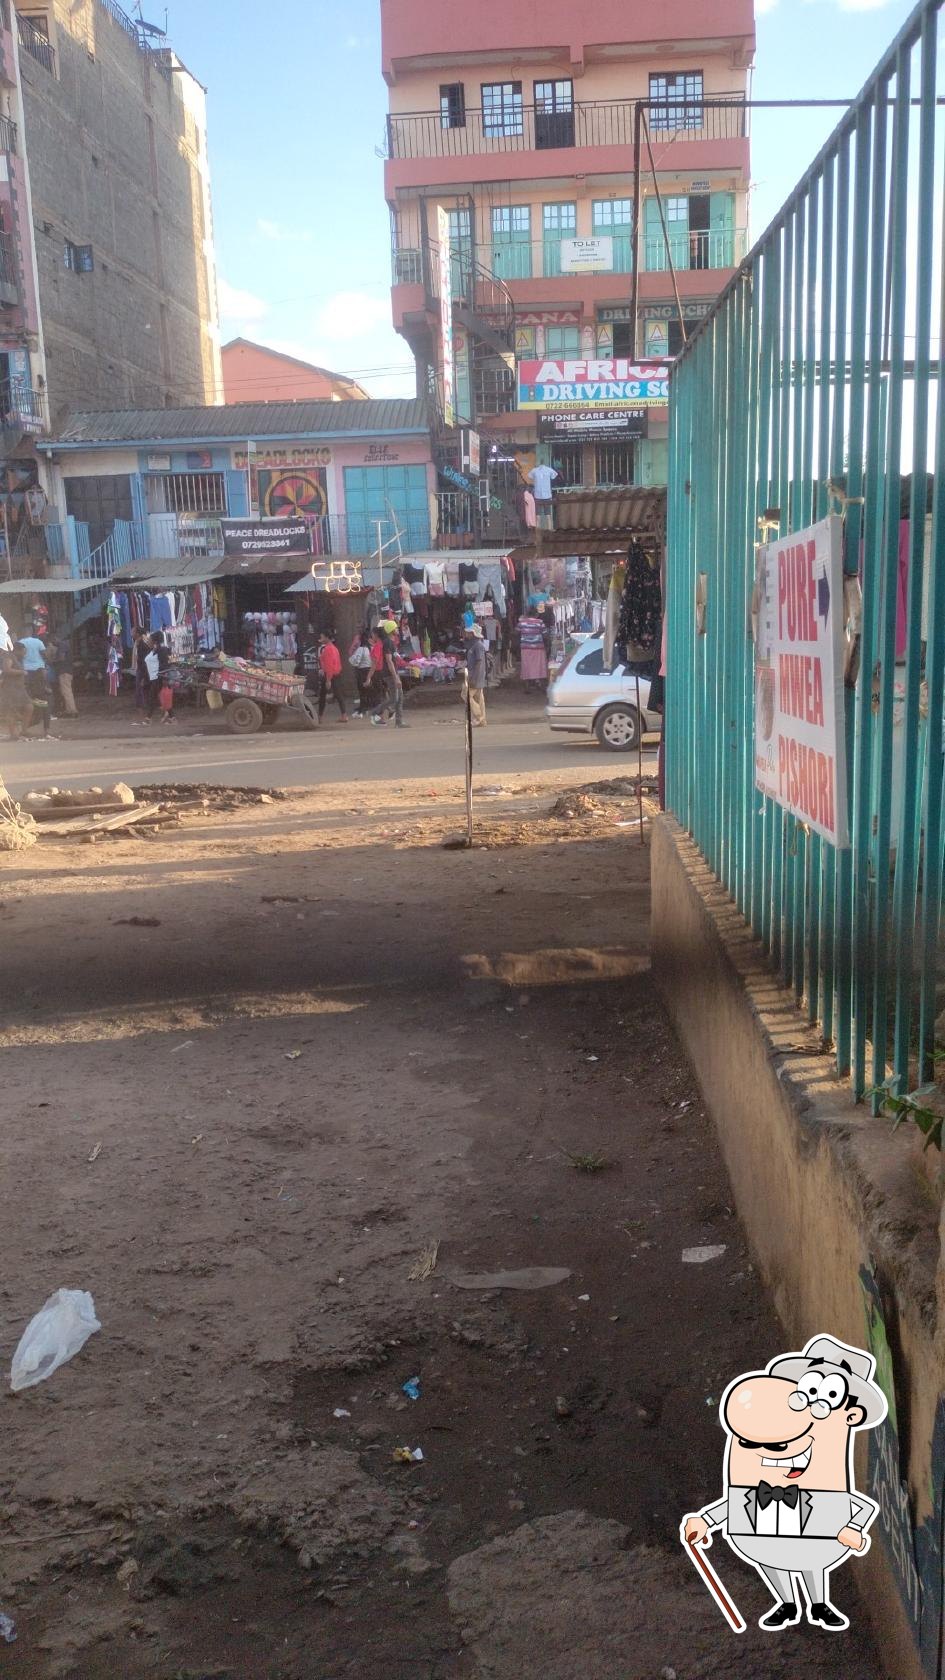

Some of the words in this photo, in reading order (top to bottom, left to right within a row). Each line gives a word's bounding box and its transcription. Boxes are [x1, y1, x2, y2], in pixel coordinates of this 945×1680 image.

[603, 306, 673, 320] DRIING
[542, 381, 641, 400] DRIVING
[541, 413, 577, 422] PHONE
[579, 412, 604, 420] CARE
[607, 410, 644, 419] CENTRE
[225, 529, 253, 537] PEACE
[253, 526, 306, 537] DREADLOCKS
[312, 560, 362, 578] CITY
[778, 539, 818, 642] PURE
[779, 653, 825, 728] MWEA
[778, 733, 835, 833] PISHORI
